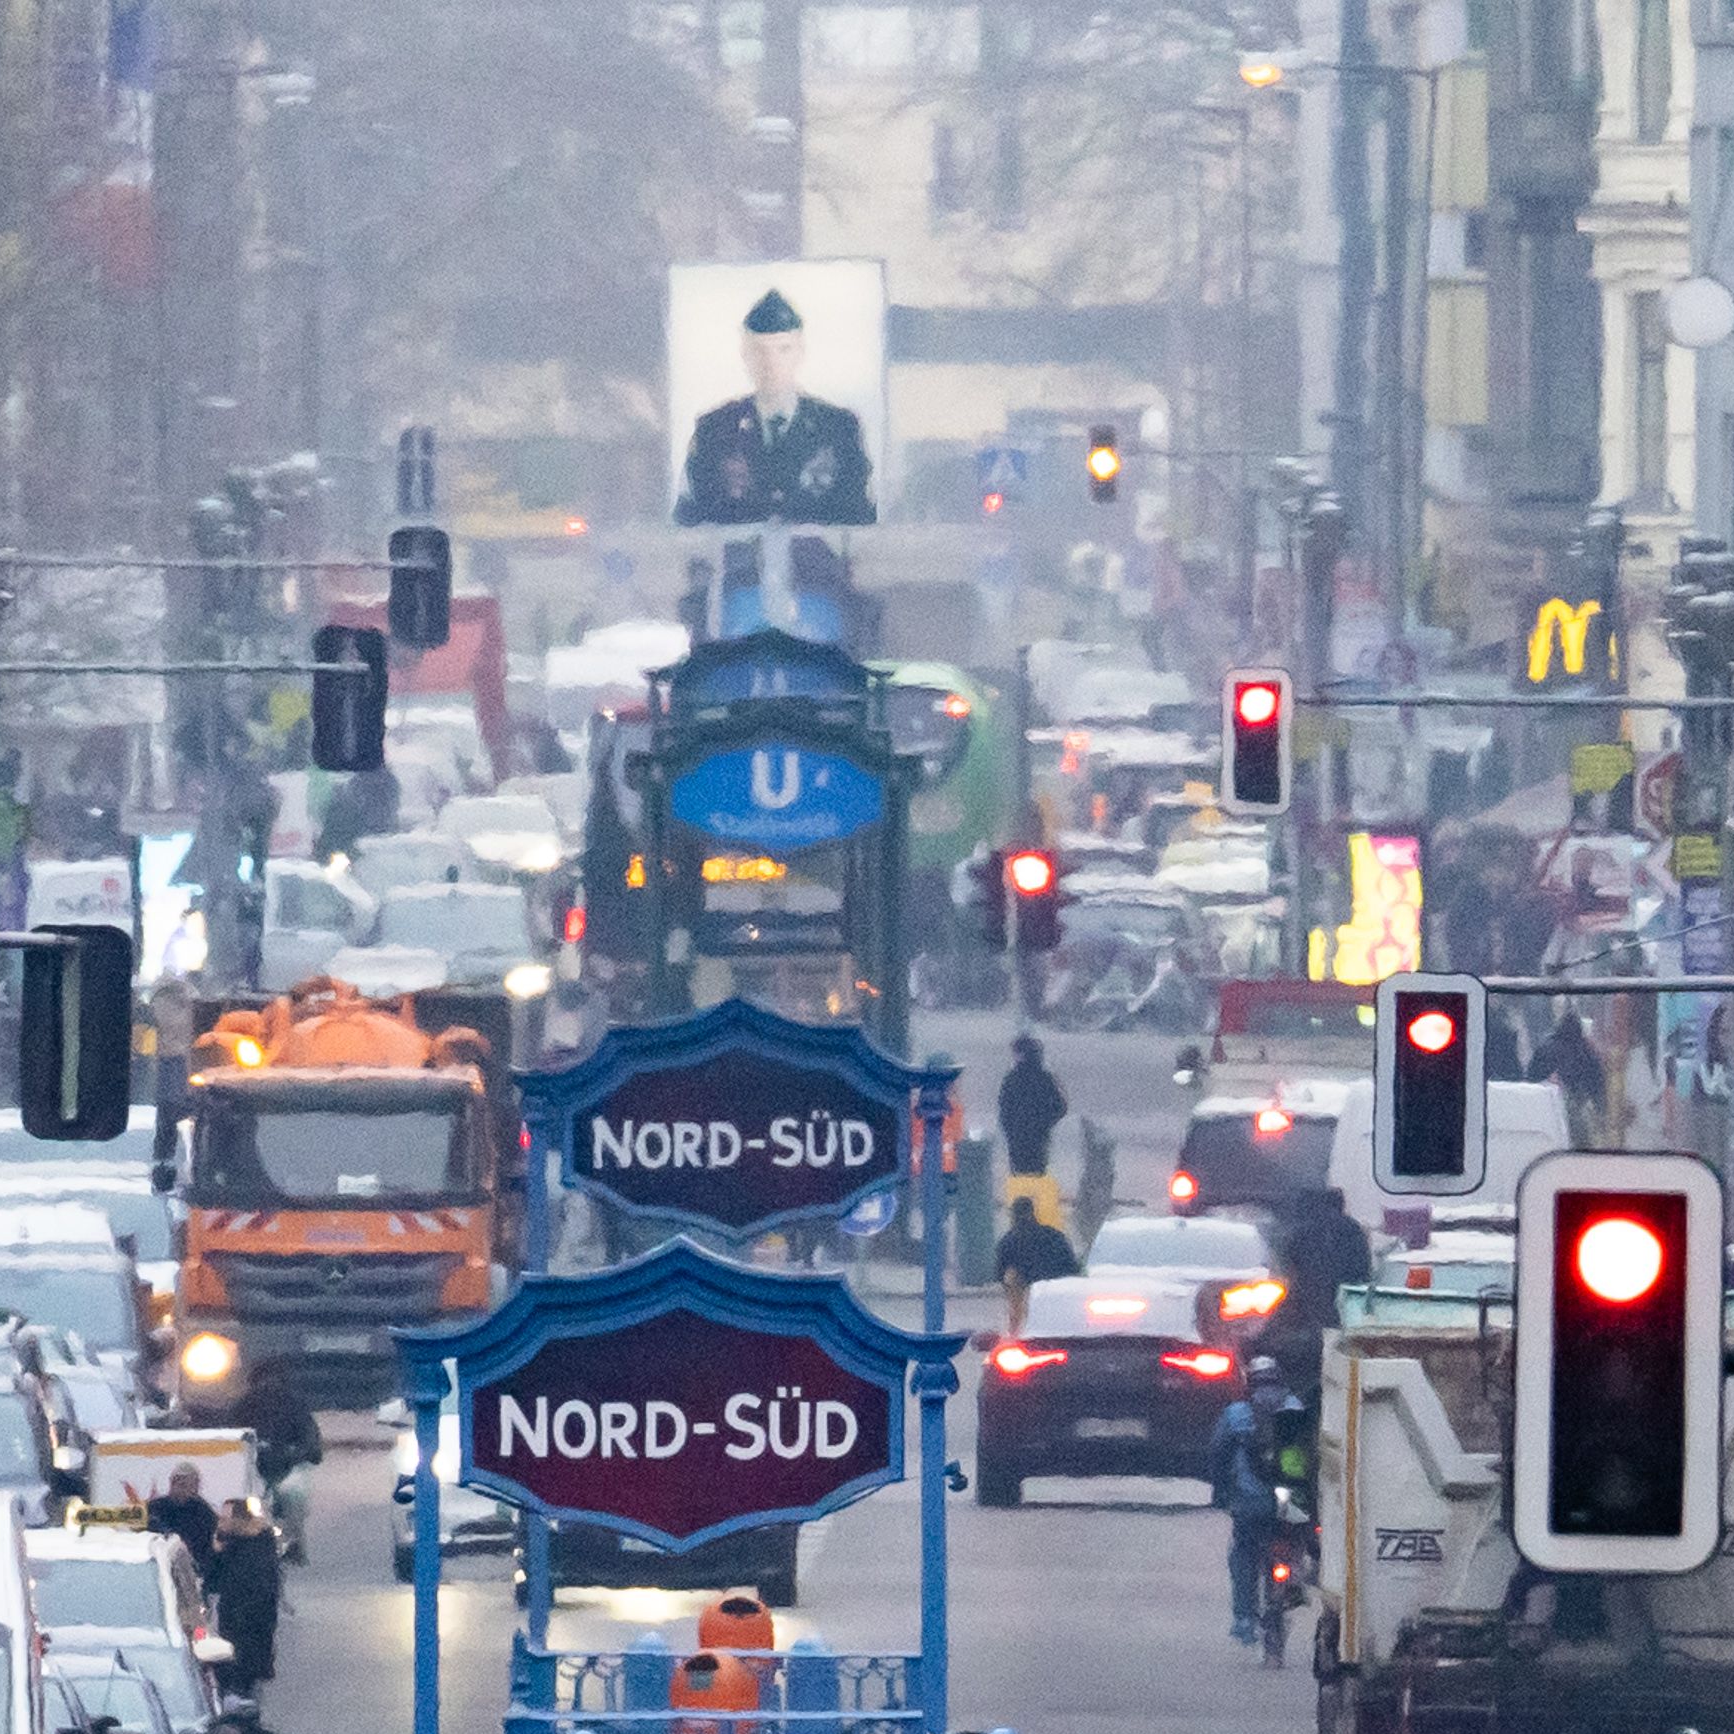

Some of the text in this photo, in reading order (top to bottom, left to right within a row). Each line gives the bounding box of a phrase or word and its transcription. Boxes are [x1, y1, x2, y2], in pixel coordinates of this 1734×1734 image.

[751, 749, 800, 809] U
[591, 1109, 874, 1170] NORD-SÜD
[498, 1386, 859, 1460] NORD-SÜD
